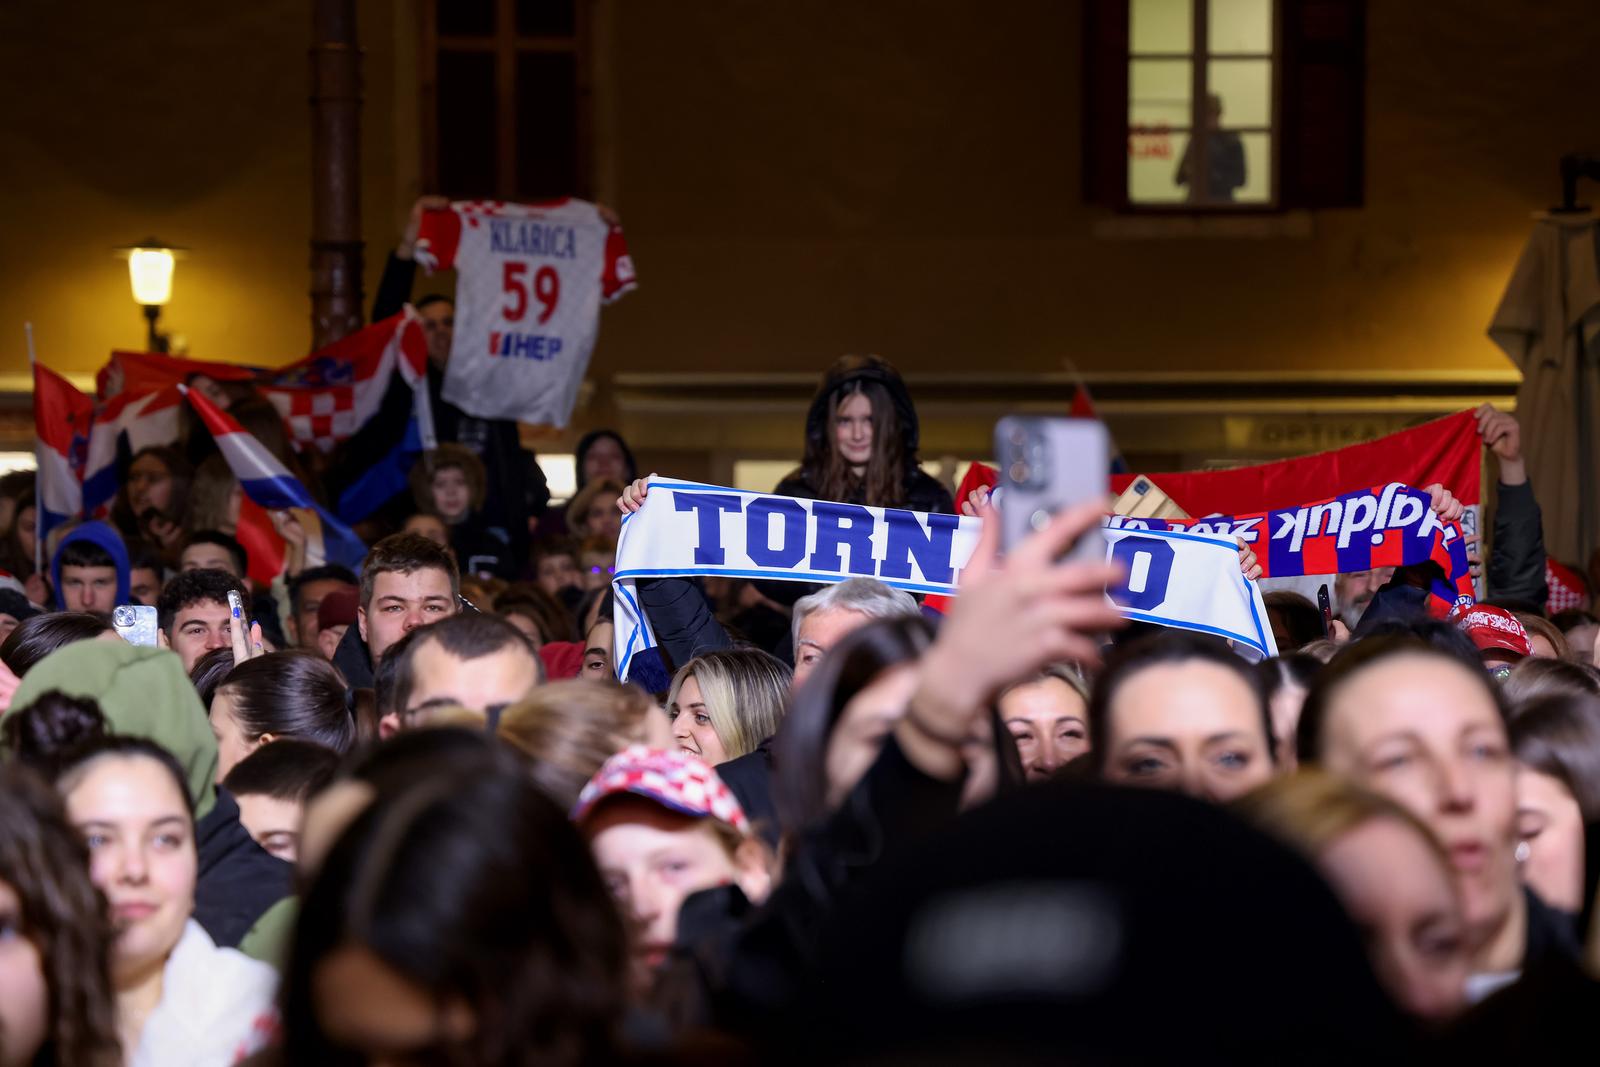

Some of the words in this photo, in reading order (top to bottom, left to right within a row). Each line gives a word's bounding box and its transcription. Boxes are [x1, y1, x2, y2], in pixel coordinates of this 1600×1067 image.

[502, 261, 560, 325] 59
[514, 335, 562, 361] HEP
[674, 492, 1175, 612] TORNO
